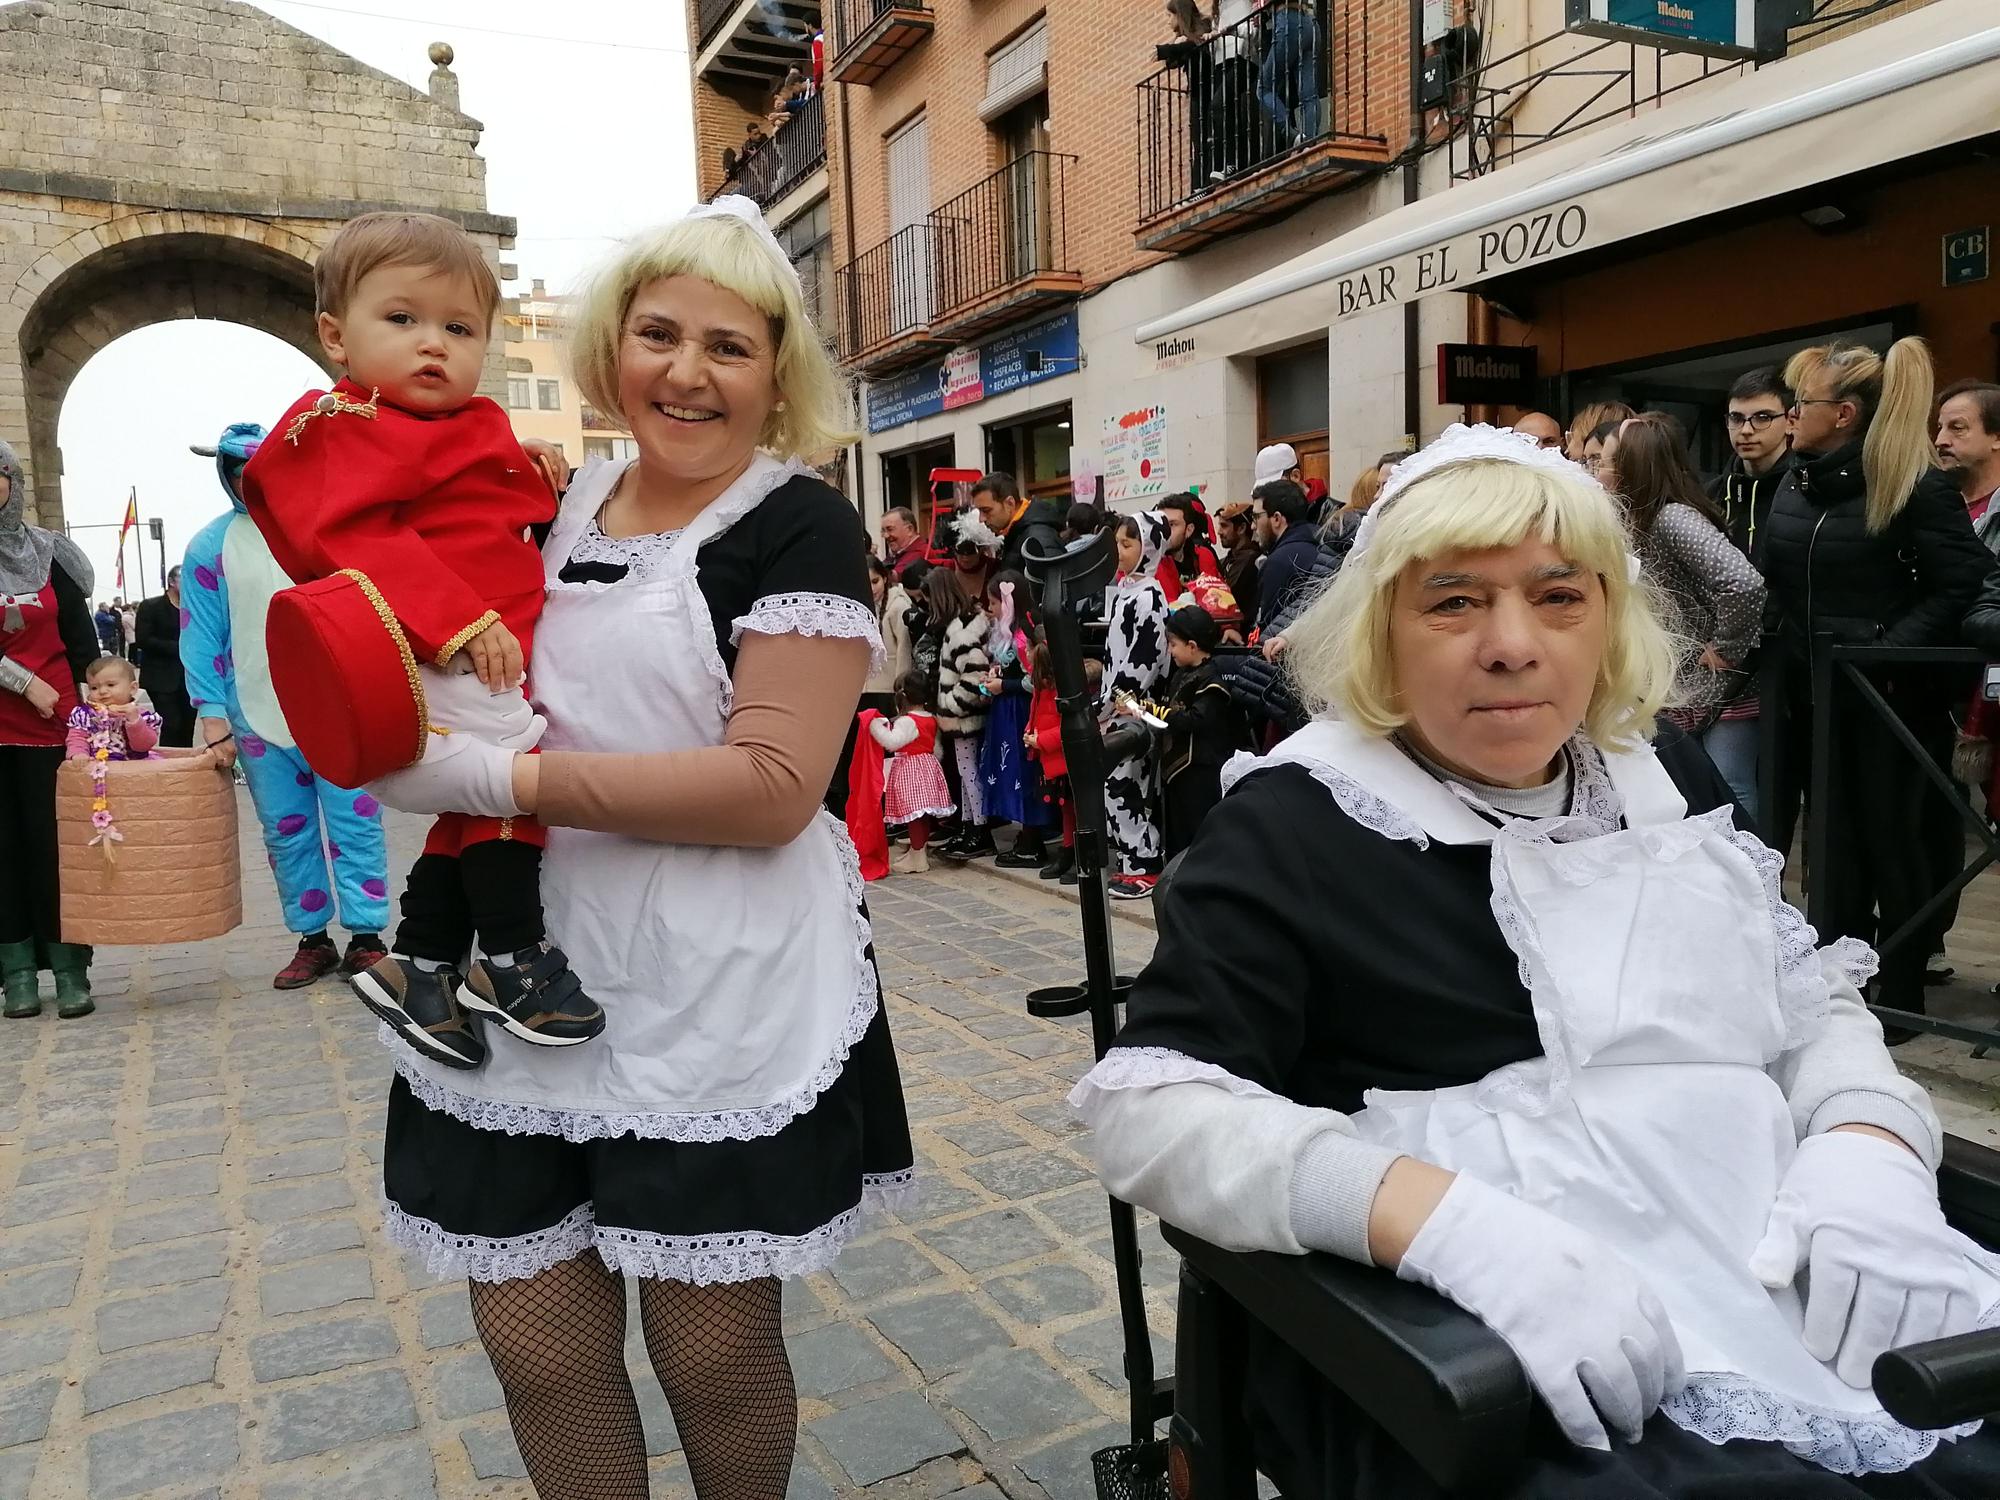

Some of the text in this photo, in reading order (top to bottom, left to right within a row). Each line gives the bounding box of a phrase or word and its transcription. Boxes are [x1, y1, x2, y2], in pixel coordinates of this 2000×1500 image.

[1657, 1, 1694, 20] Mahou
[1948, 234, 1984, 259] CB
[1337, 203, 1588, 318] BAR EL POZO
[994, 347, 1020, 366] JUGUETES
[1156, 337, 1195, 361] Mahou
[993, 360, 1022, 379] DISFRACES
[1455, 355, 1521, 380] Mahou
[993, 375, 1020, 392] RECARGA
[1021, 371, 1029, 383] de
[911, 388, 942, 407] PLASTIFICADO
[872, 418, 890, 430] MATERIAL
[896, 410, 913, 422] OFICINA
